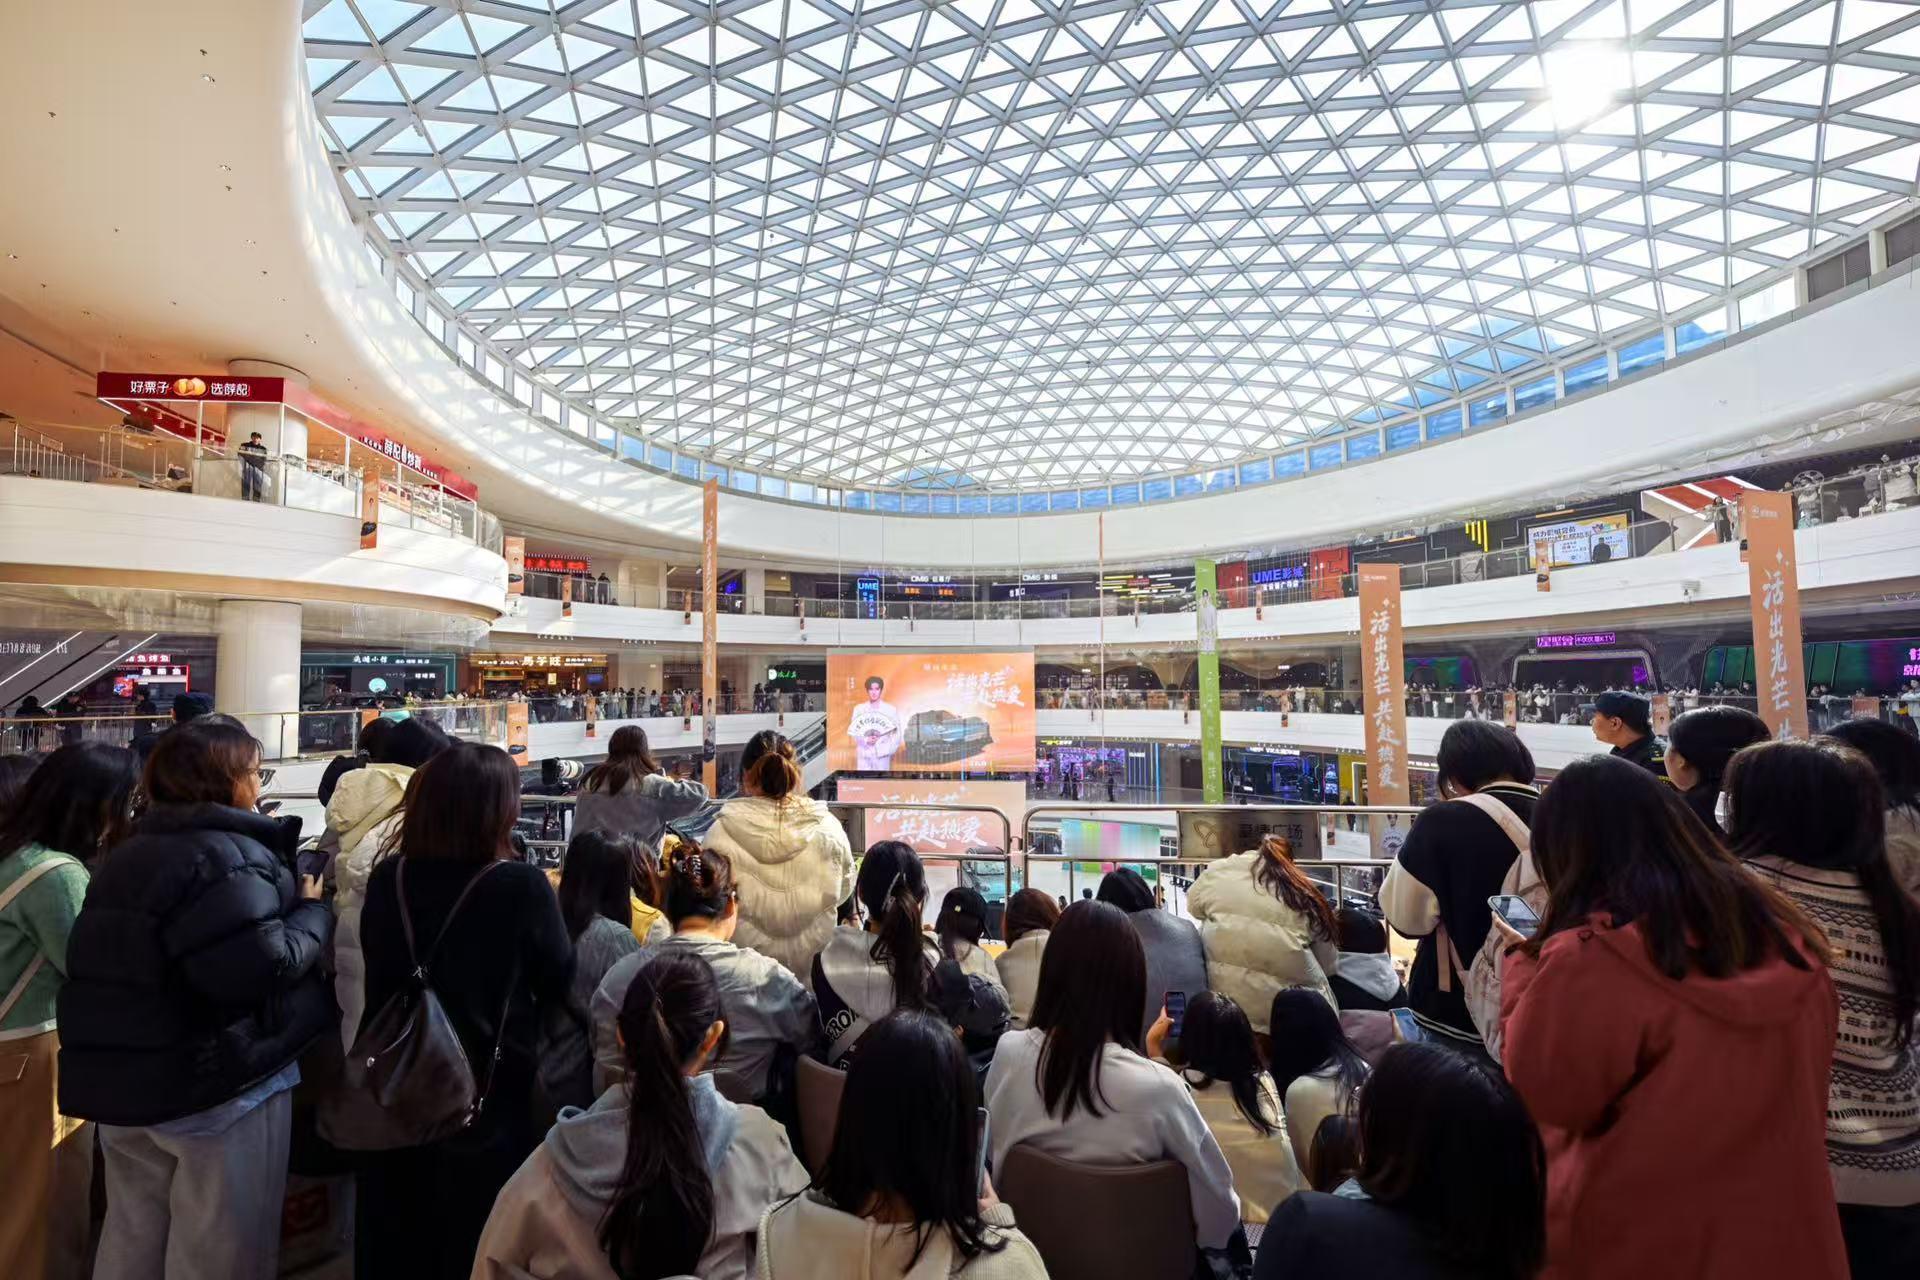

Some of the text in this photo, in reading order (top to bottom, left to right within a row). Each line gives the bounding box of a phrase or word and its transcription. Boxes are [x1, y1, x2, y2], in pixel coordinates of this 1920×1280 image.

[858, 582, 878, 590] UME
[1252, 566, 1304, 583] UME影城
[1370, 610, 1392, 695] 活出光芒
[1761, 568, 1790, 711] 活出光芒
[1373, 699, 1400, 788] 共赴热爱
[892, 815, 988, 849] 共赴热爱
